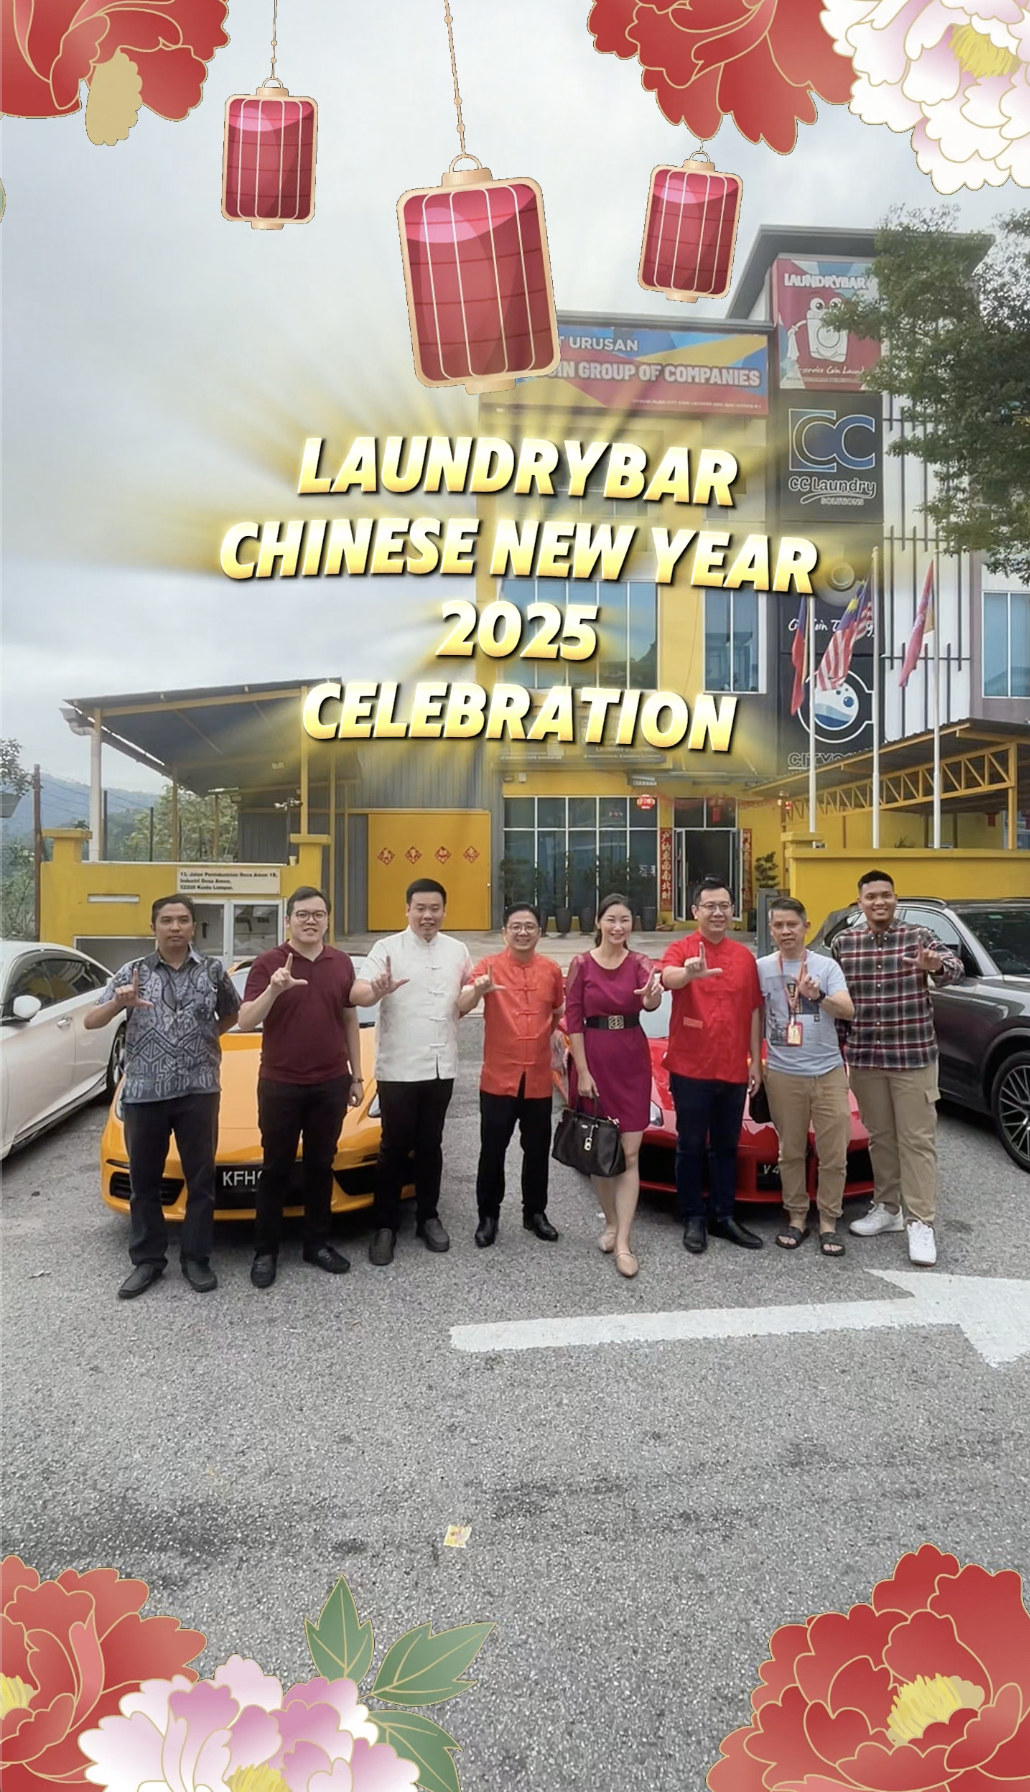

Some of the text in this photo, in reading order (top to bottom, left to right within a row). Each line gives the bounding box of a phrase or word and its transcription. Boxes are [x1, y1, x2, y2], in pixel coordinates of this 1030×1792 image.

[784, 273, 868, 290] LAUNDRYBAR
[569, 336, 638, 352] URUSAN
[578, 362, 636, 380] GROUP
[638, 365, 662, 382] OF
[664, 366, 761, 386] COMPANIES
[788, 476, 877, 499] CC Laundry
